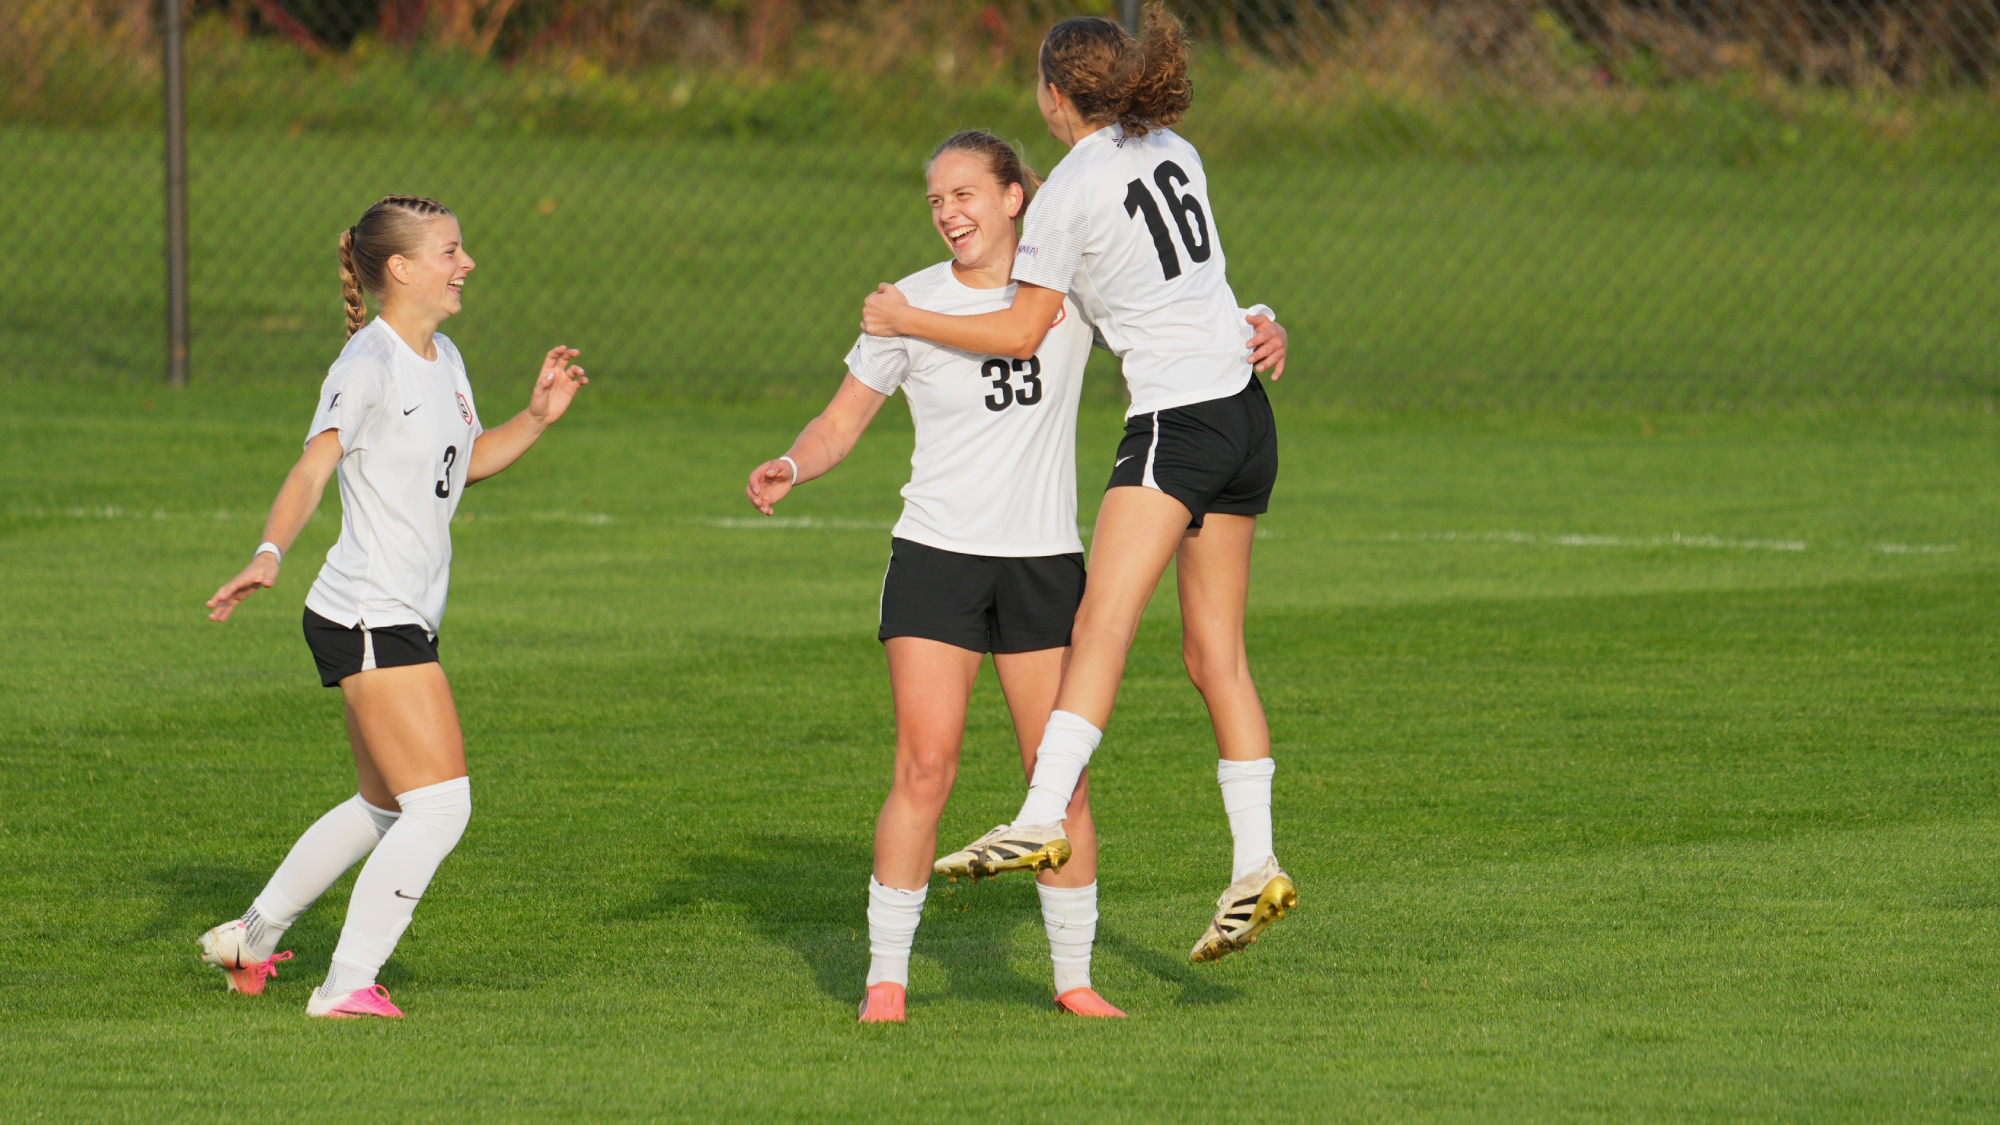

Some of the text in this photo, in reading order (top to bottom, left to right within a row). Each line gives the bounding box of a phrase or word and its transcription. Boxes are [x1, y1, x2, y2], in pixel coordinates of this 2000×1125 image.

[1123, 160, 1211, 281] 16
[981, 355, 1042, 412] 33
[435, 445, 457, 499] 3
